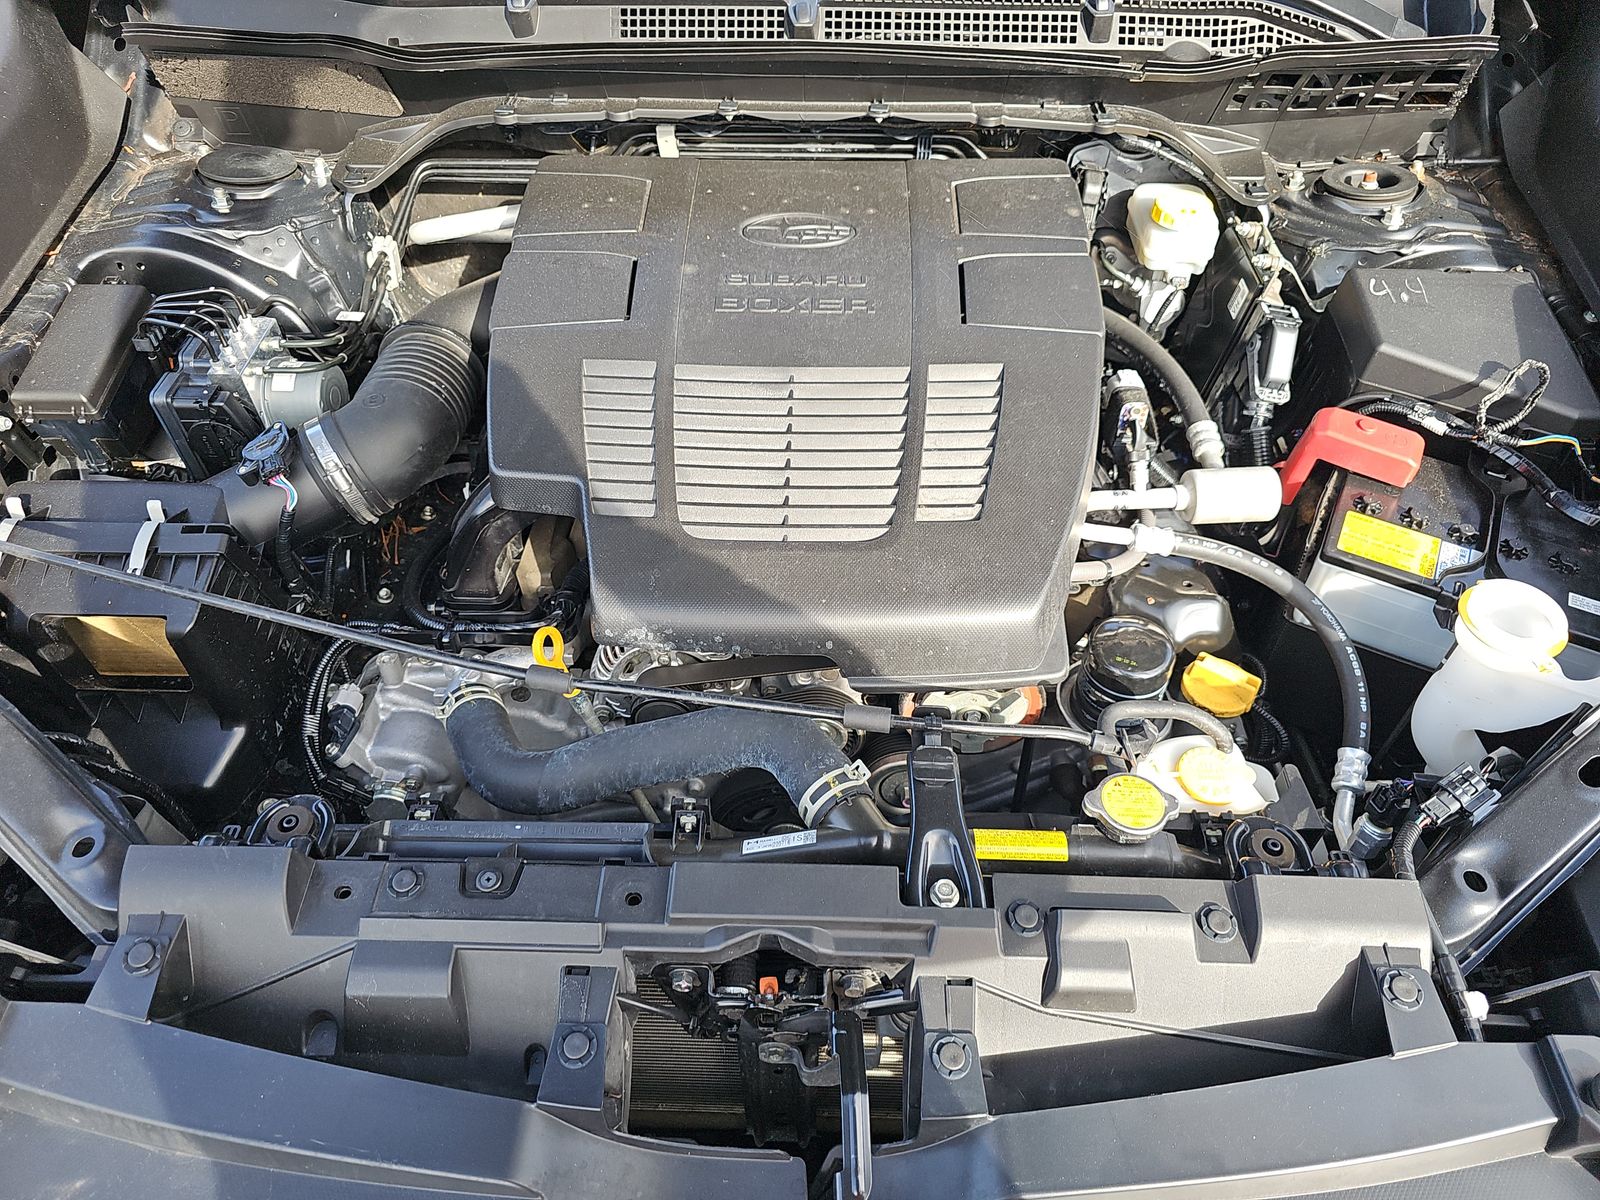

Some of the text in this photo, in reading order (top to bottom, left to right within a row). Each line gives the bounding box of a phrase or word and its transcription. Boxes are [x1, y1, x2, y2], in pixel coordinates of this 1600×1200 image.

[725, 272, 868, 287] SUBARU
[1369, 276, 1429, 304] 4.4
[714, 297, 876, 314] BOXER
[1319, 605, 1347, 642] YOKOHAMA
